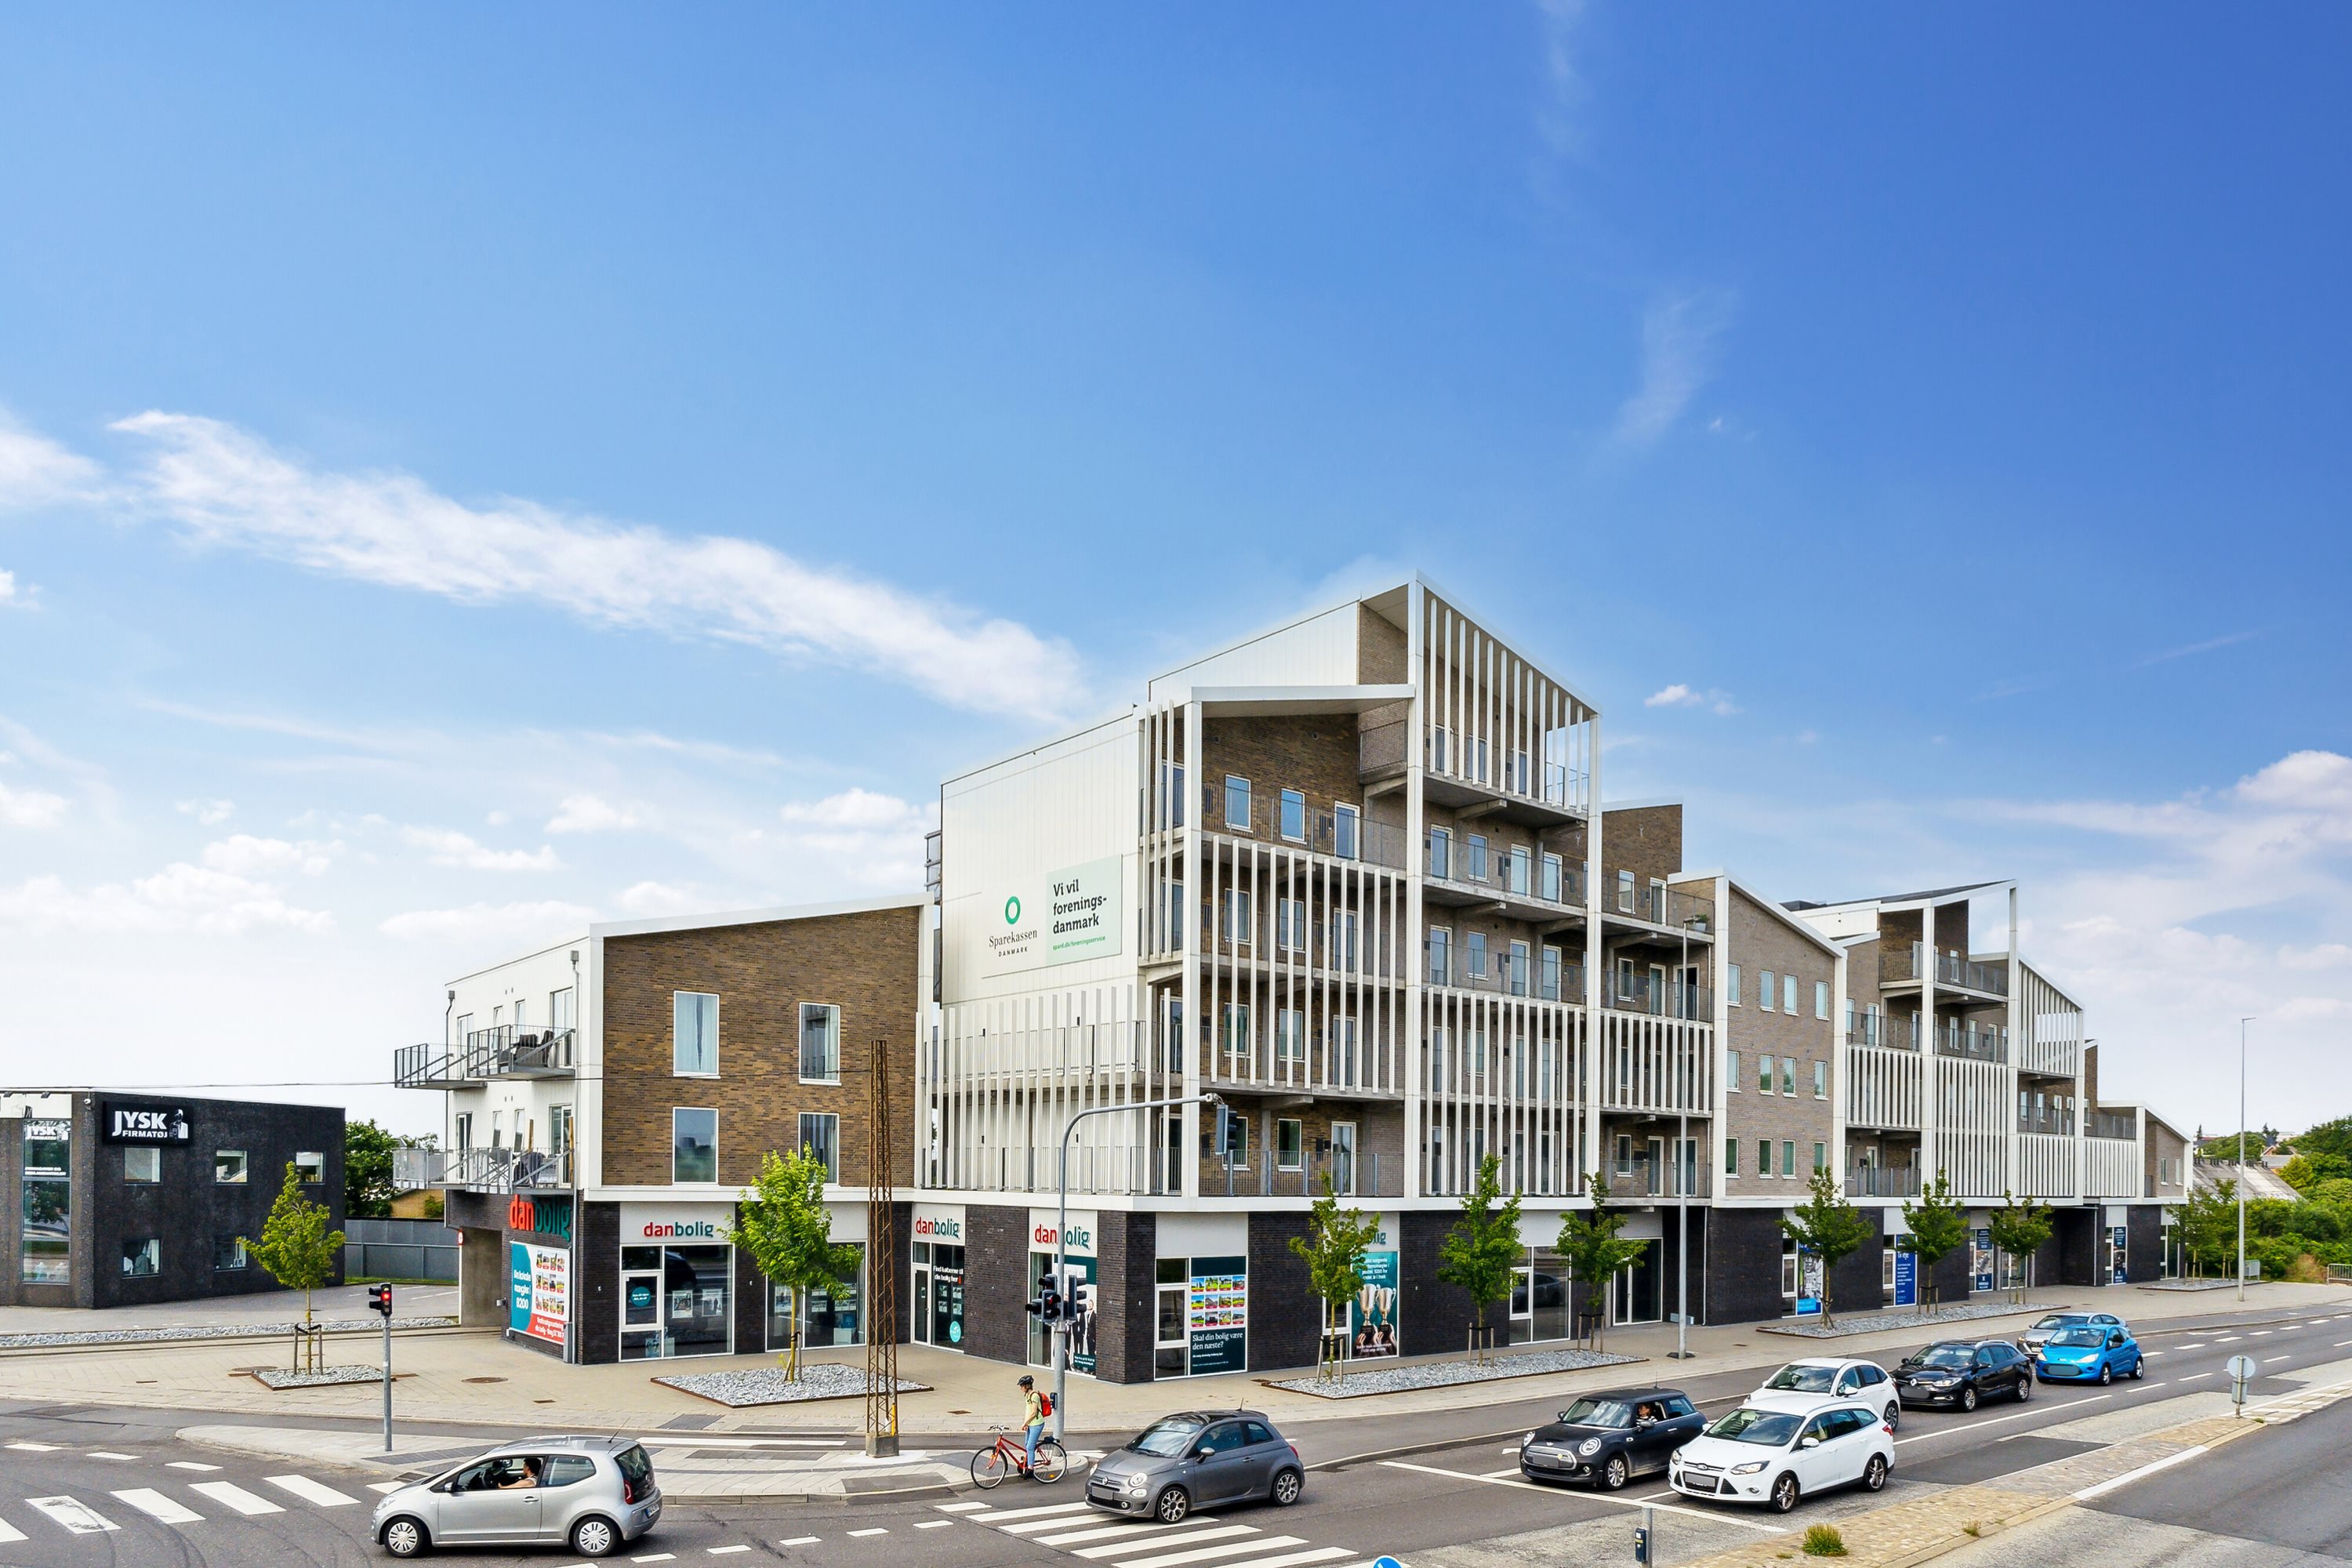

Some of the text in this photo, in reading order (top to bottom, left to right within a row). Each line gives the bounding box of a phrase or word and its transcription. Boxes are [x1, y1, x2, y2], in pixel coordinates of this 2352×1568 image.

[1053, 879, 1079, 897] Vi vil
[1053, 895, 1107, 916] forenings-
[1053, 913, 1099, 934] danmark
[989, 930, 1037, 949] Sparekassen
[998, 946, 1028, 957] DANMARK
[112, 1110, 167, 1136] JYSK
[122, 1130, 168, 1138] FIRMATØJ
[510, 1194, 571, 1242] danbolig
[644, 1221, 714, 1238] danbolig
[916, 1217, 960, 1240] danbolig
[1035, 1224, 1091, 1250] danolig
[516, 1297, 529, 1310] 9200
[1215, 1333, 1229, 1341] bolig
